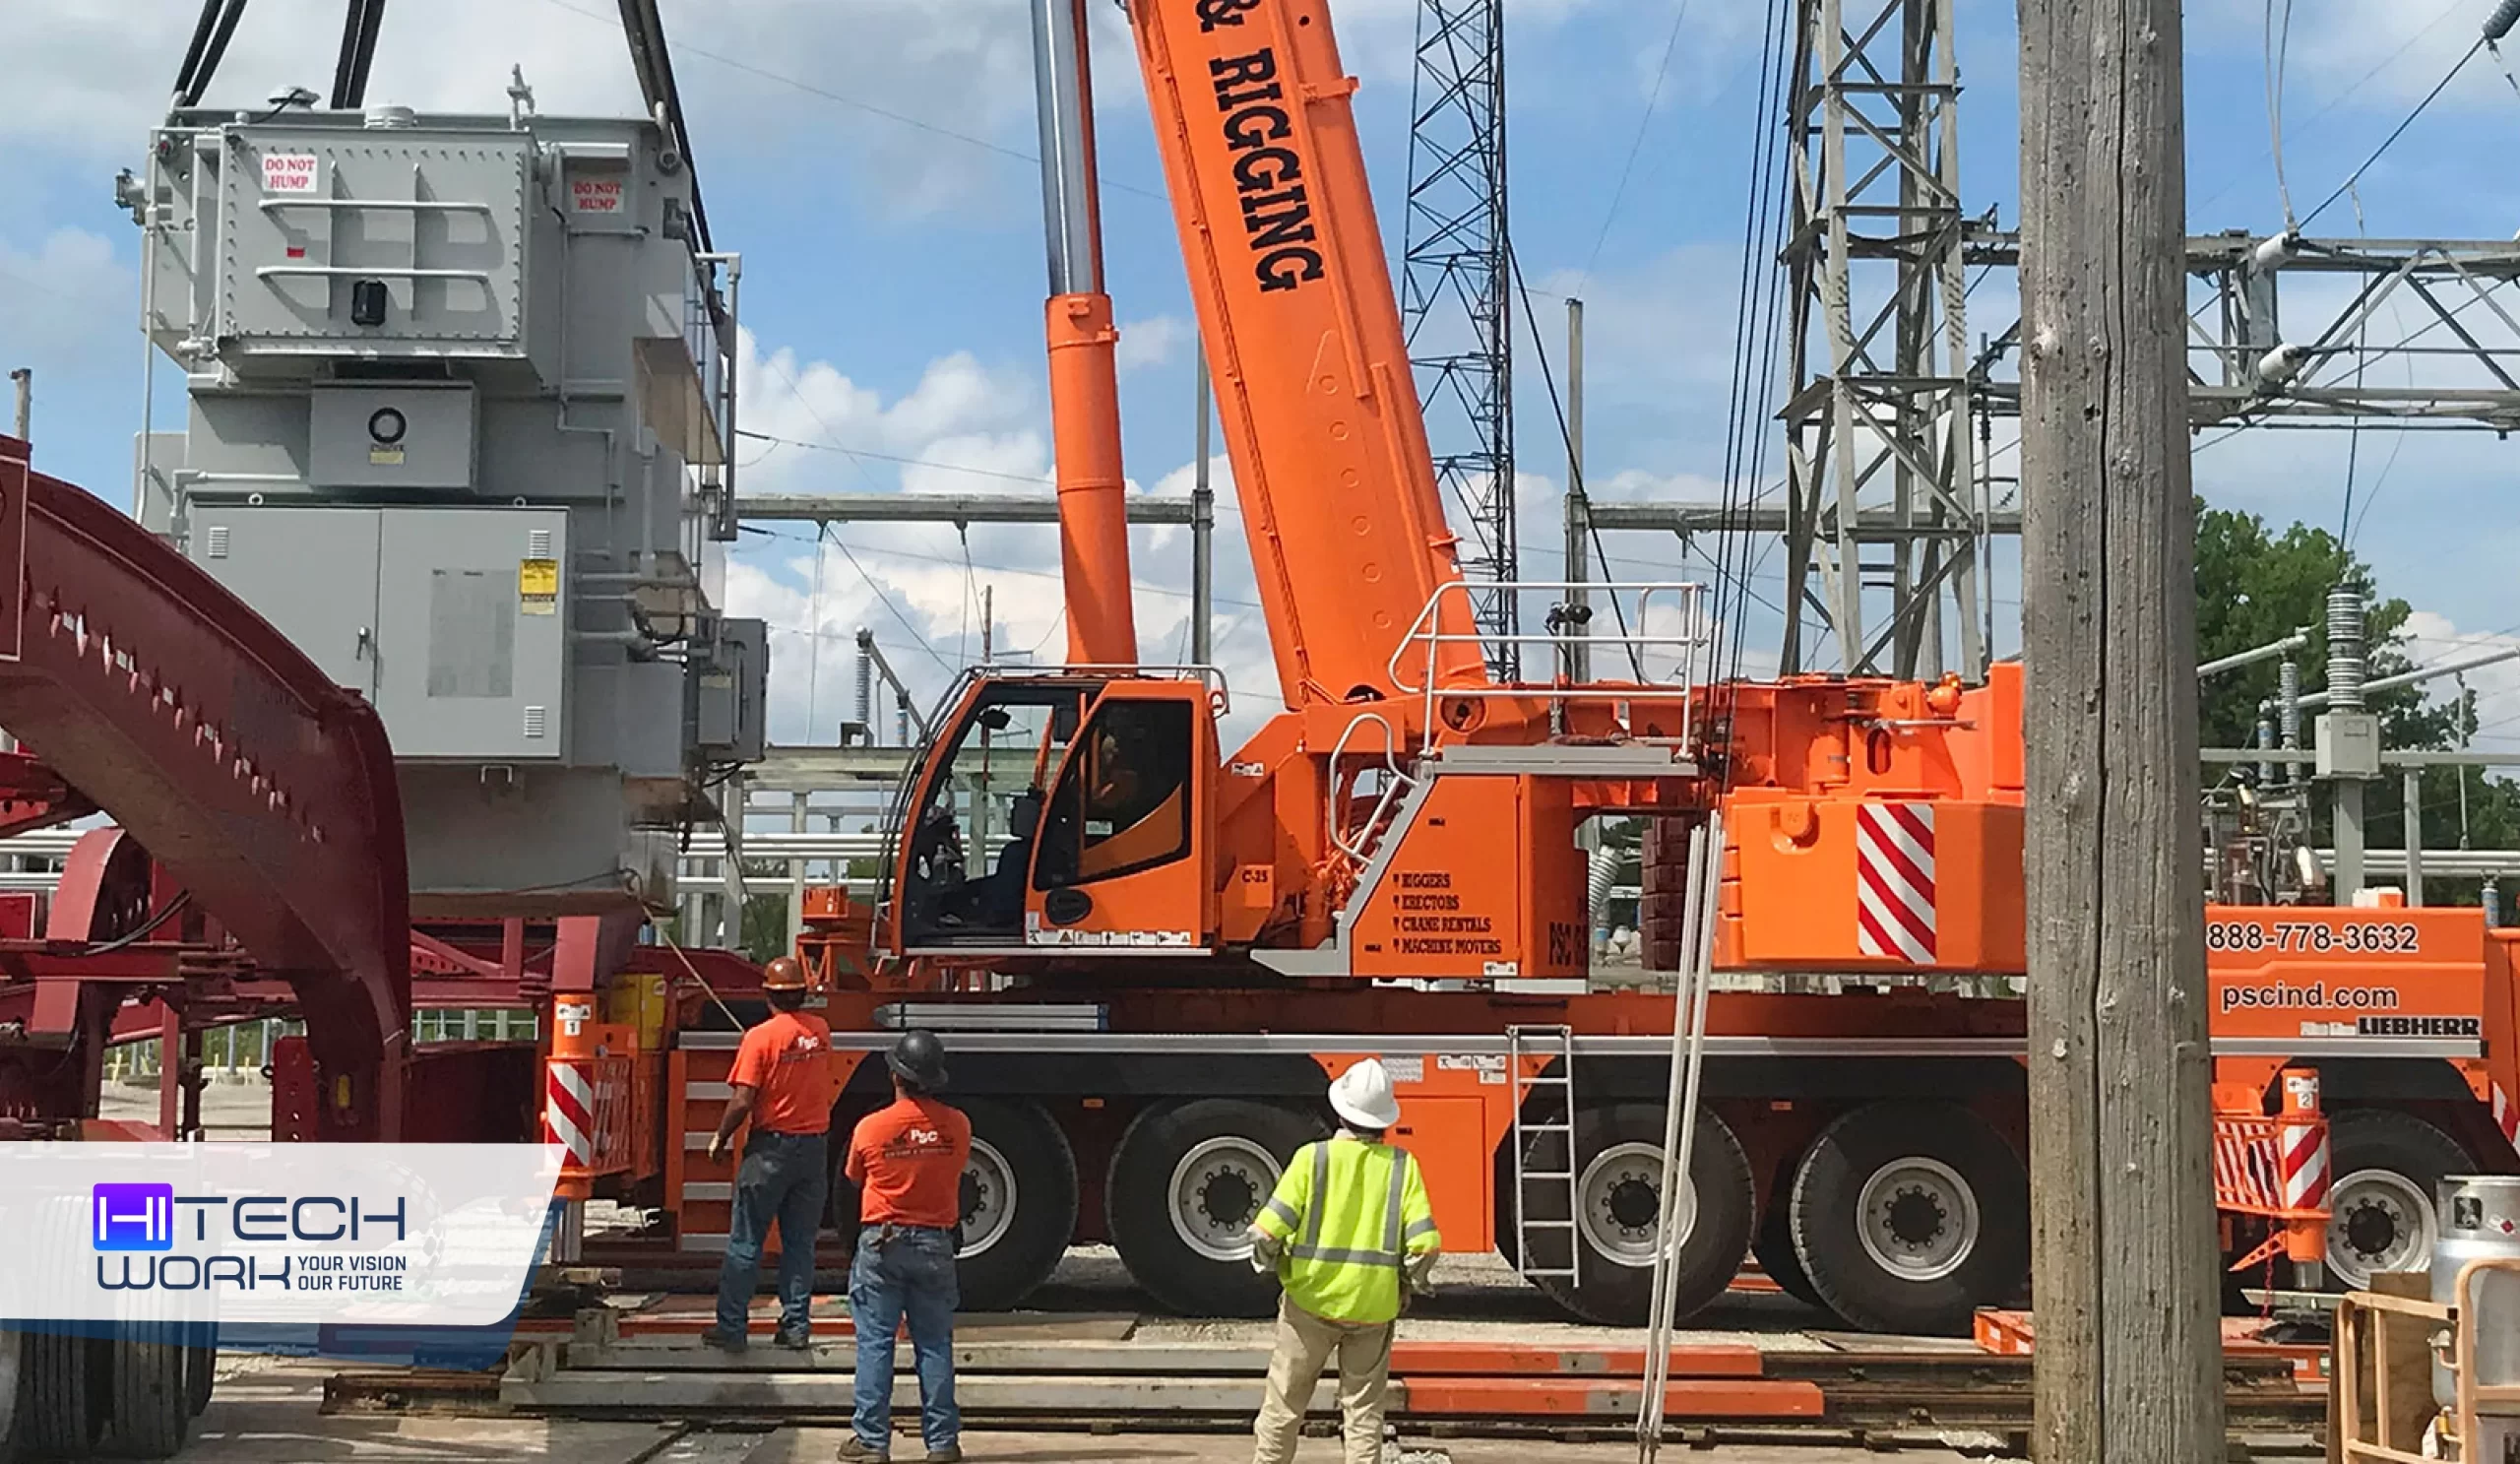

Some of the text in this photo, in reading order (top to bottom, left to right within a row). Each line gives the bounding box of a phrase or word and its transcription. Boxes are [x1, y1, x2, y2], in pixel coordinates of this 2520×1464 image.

[1195, 0, 1325, 293] & RIGGING
[265, 159, 315, 171] DO NOT
[270, 175, 309, 190] HUMP
[574, 181, 622, 195] DO NOT
[579, 198, 616, 211] HUMP
[1401, 873, 1451, 889] RIGGERS
[1401, 894, 1460, 911] ERECTORS
[1401, 916, 1492, 933] CRANE RENTALS
[2207, 923, 2419, 952] 888-778-3632
[1401, 938, 1453, 954] MACHINE
[1455, 938, 1502, 955] MOVERS
[2222, 982, 2399, 1013] pscind.com
[2358, 1016, 2481, 1036] LIEBHERR
[2300, 1093, 2311, 1108] 2
[910, 1128, 939, 1144] PSC
